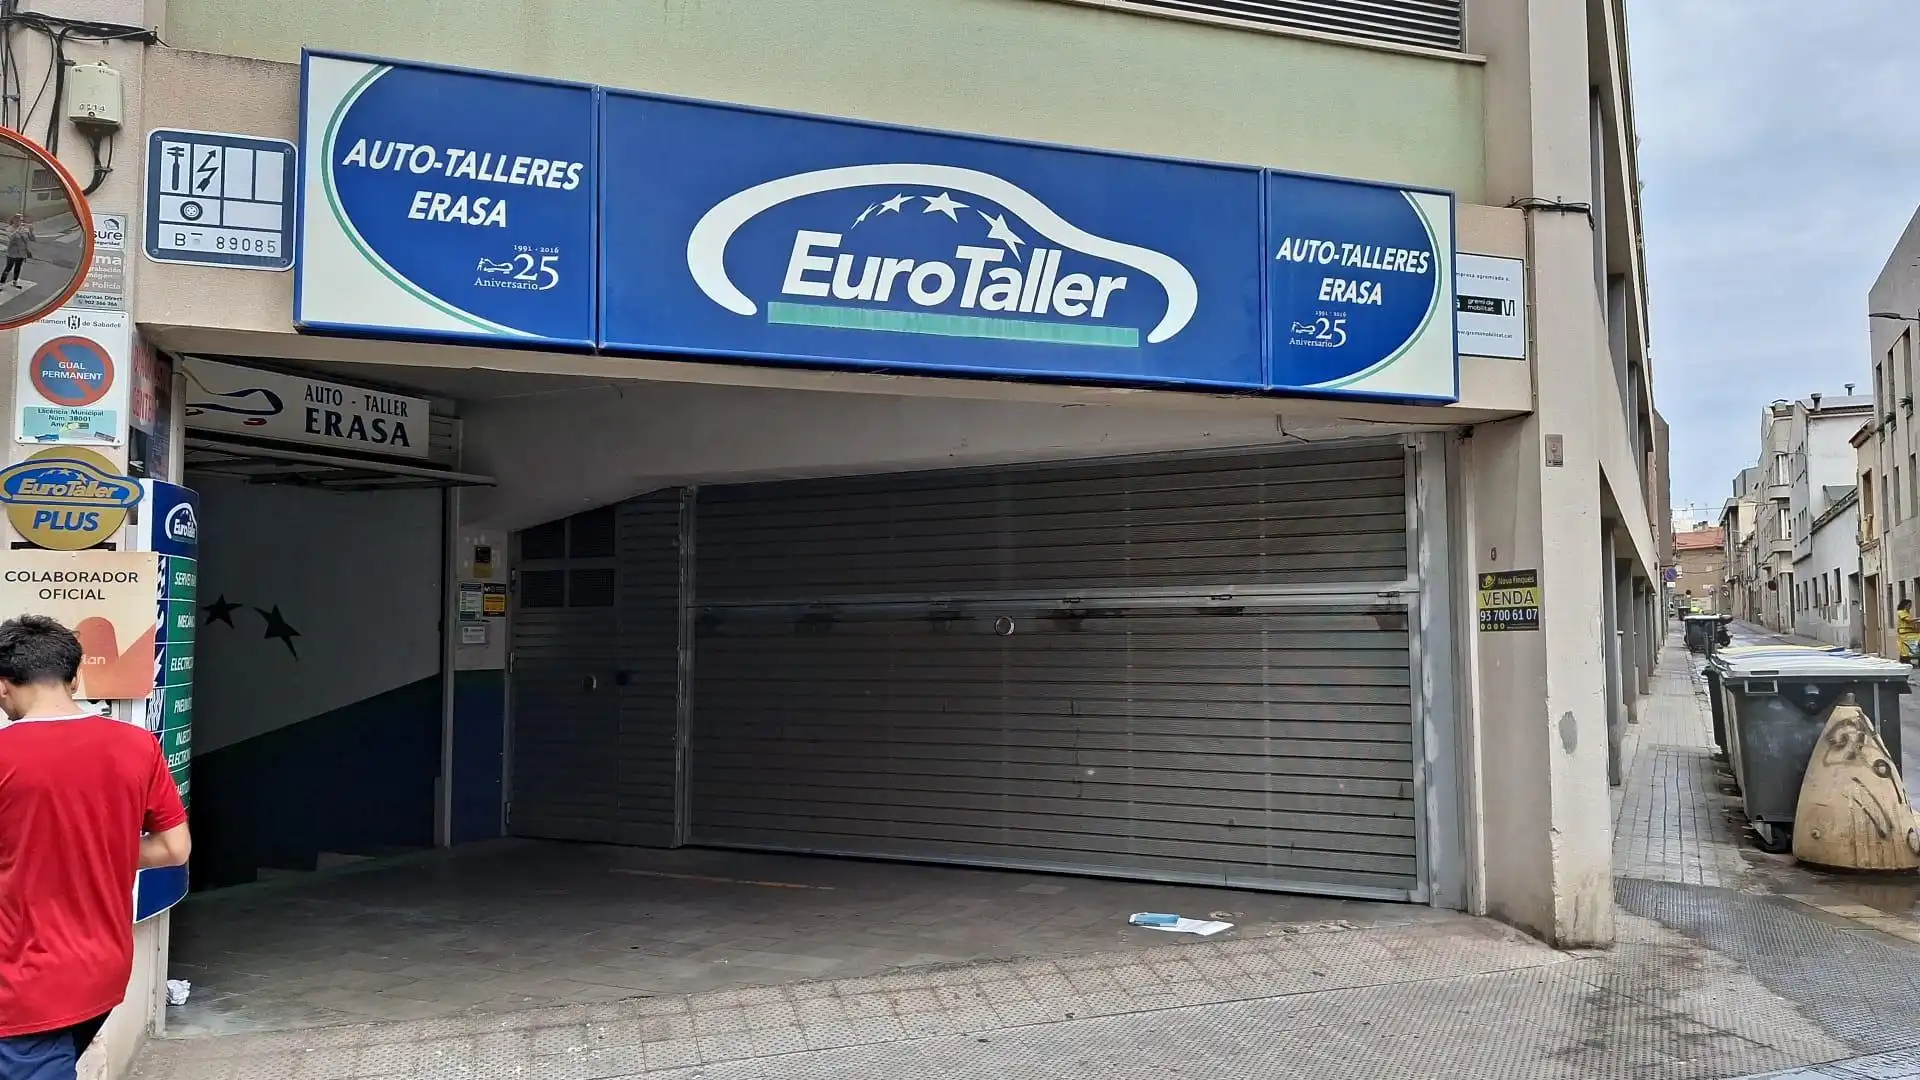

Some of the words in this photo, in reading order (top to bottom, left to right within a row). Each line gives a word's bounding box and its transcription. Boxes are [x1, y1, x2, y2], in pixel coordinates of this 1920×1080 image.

[342, 138, 584, 191] AUTO-TALLERES
[407, 191, 507, 228] ERASA
[216, 236, 276, 253] 89085
[1275, 237, 1430, 274] AUTO-TALLERES
[513, 253, 559, 290] 25
[781, 230, 1127, 318] EuroTaller
[474, 277, 538, 290] Aniversario
[1318, 278, 1382, 306] ERASA
[1467, 298, 1485, 306] gremi
[92, 320, 122, 328] Sabadell
[1315, 317, 1347, 348] 25
[1289, 337, 1333, 348] Aniversario
[58, 361, 86, 370] GUAL
[42, 370, 103, 380] PERMANENT
[304, 384, 343, 406] AUTO
[364, 394, 408, 418] TALLER
[71, 409, 104, 417] Municipal
[305, 406, 411, 447] ERASA
[18, 478, 119, 498] EuroTaller
[33, 510, 99, 532] PLUS
[5, 571, 139, 584] COLABORADOR
[38, 588, 106, 600] OFICIAL
[1482, 590, 1534, 606] VENDA
[1480, 611, 1491, 621] 93
[1493, 610, 1510, 621] 700
[1512, 609, 1524, 620] 61
[1526, 608, 1537, 620] 07
